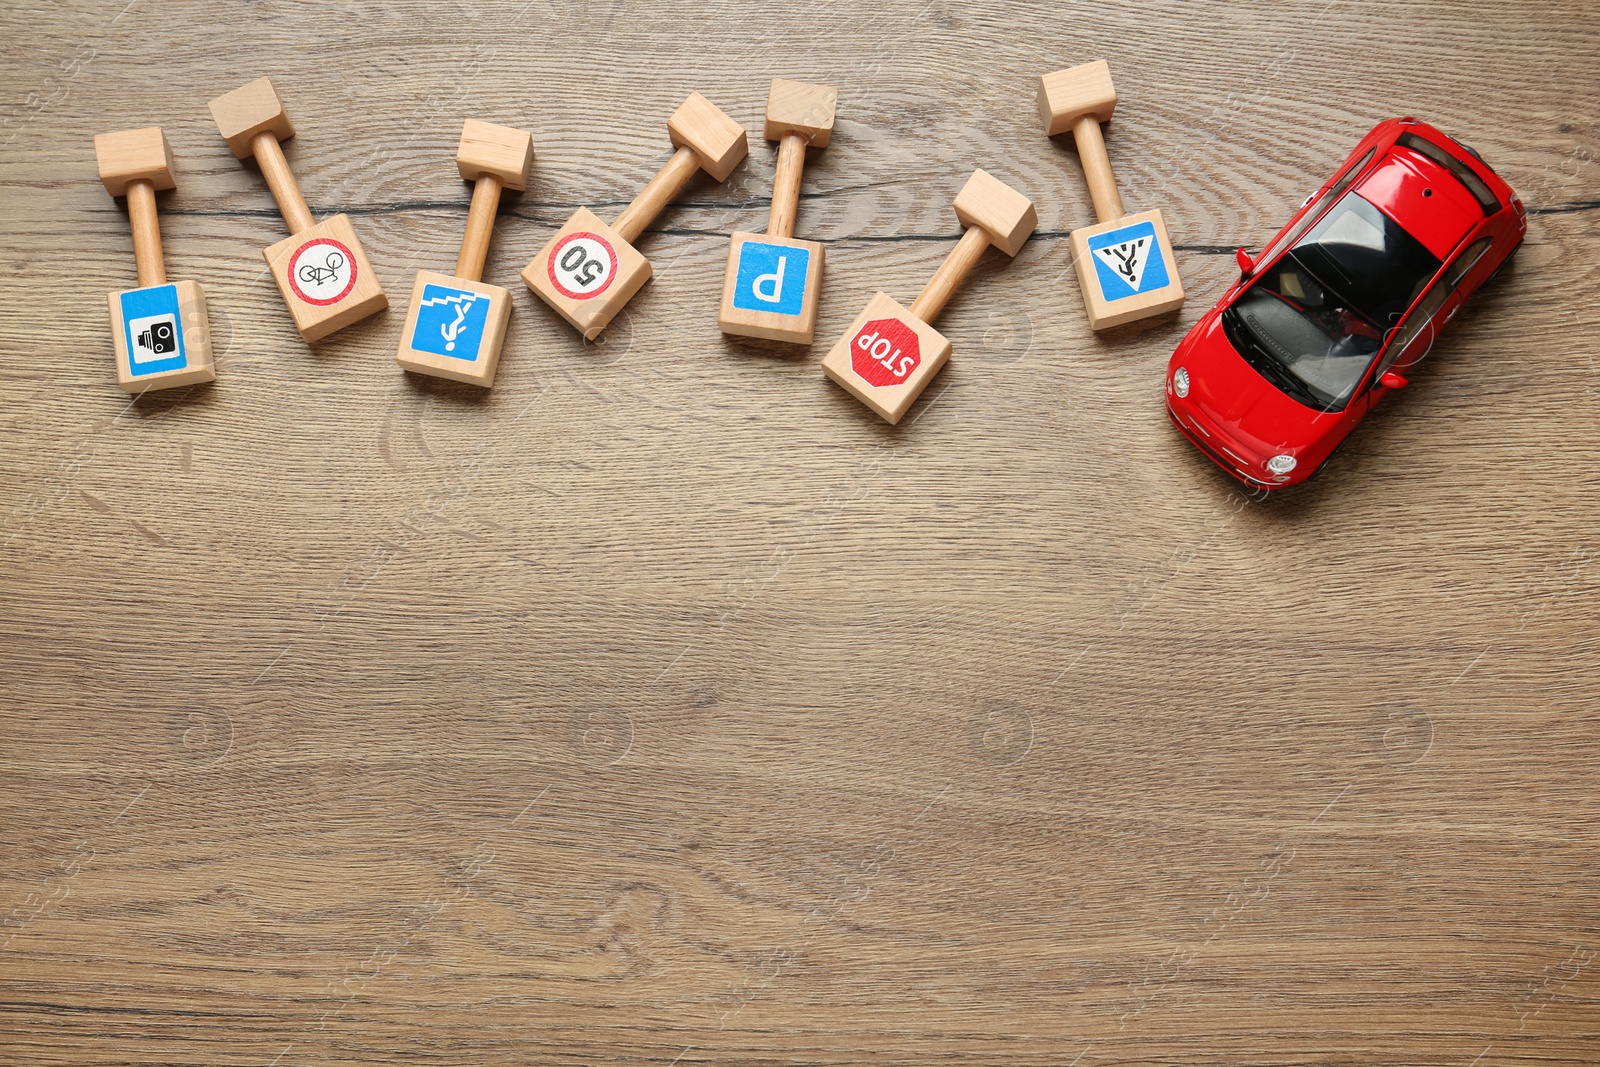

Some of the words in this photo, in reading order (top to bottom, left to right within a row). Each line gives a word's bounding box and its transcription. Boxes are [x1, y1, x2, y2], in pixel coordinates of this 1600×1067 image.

[560, 245, 604, 287] 50
[752, 256, 787, 304] P
[857, 331, 915, 377] STOP
